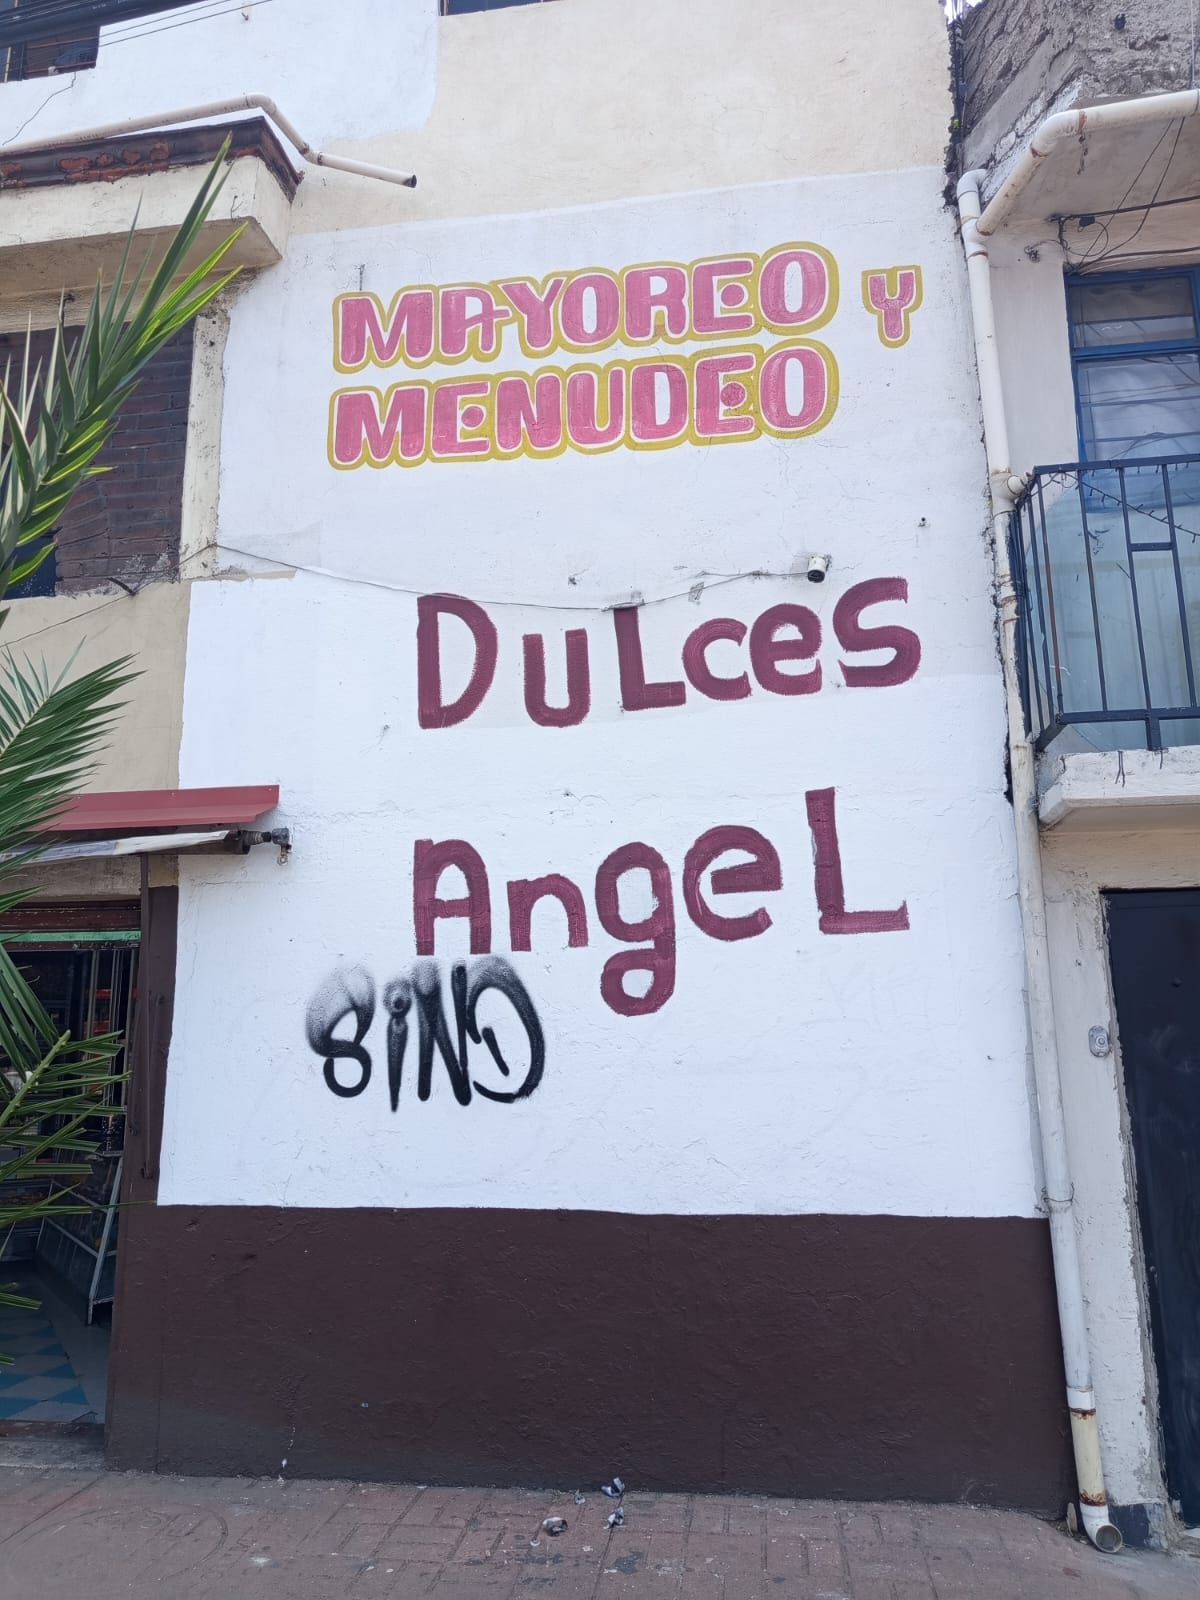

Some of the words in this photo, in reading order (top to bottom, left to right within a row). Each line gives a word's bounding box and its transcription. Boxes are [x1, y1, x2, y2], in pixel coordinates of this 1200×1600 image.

[334, 242, 837, 372] MAYOREO
[863, 266, 922, 347] Y
[328, 341, 838, 469] MENUDEO
